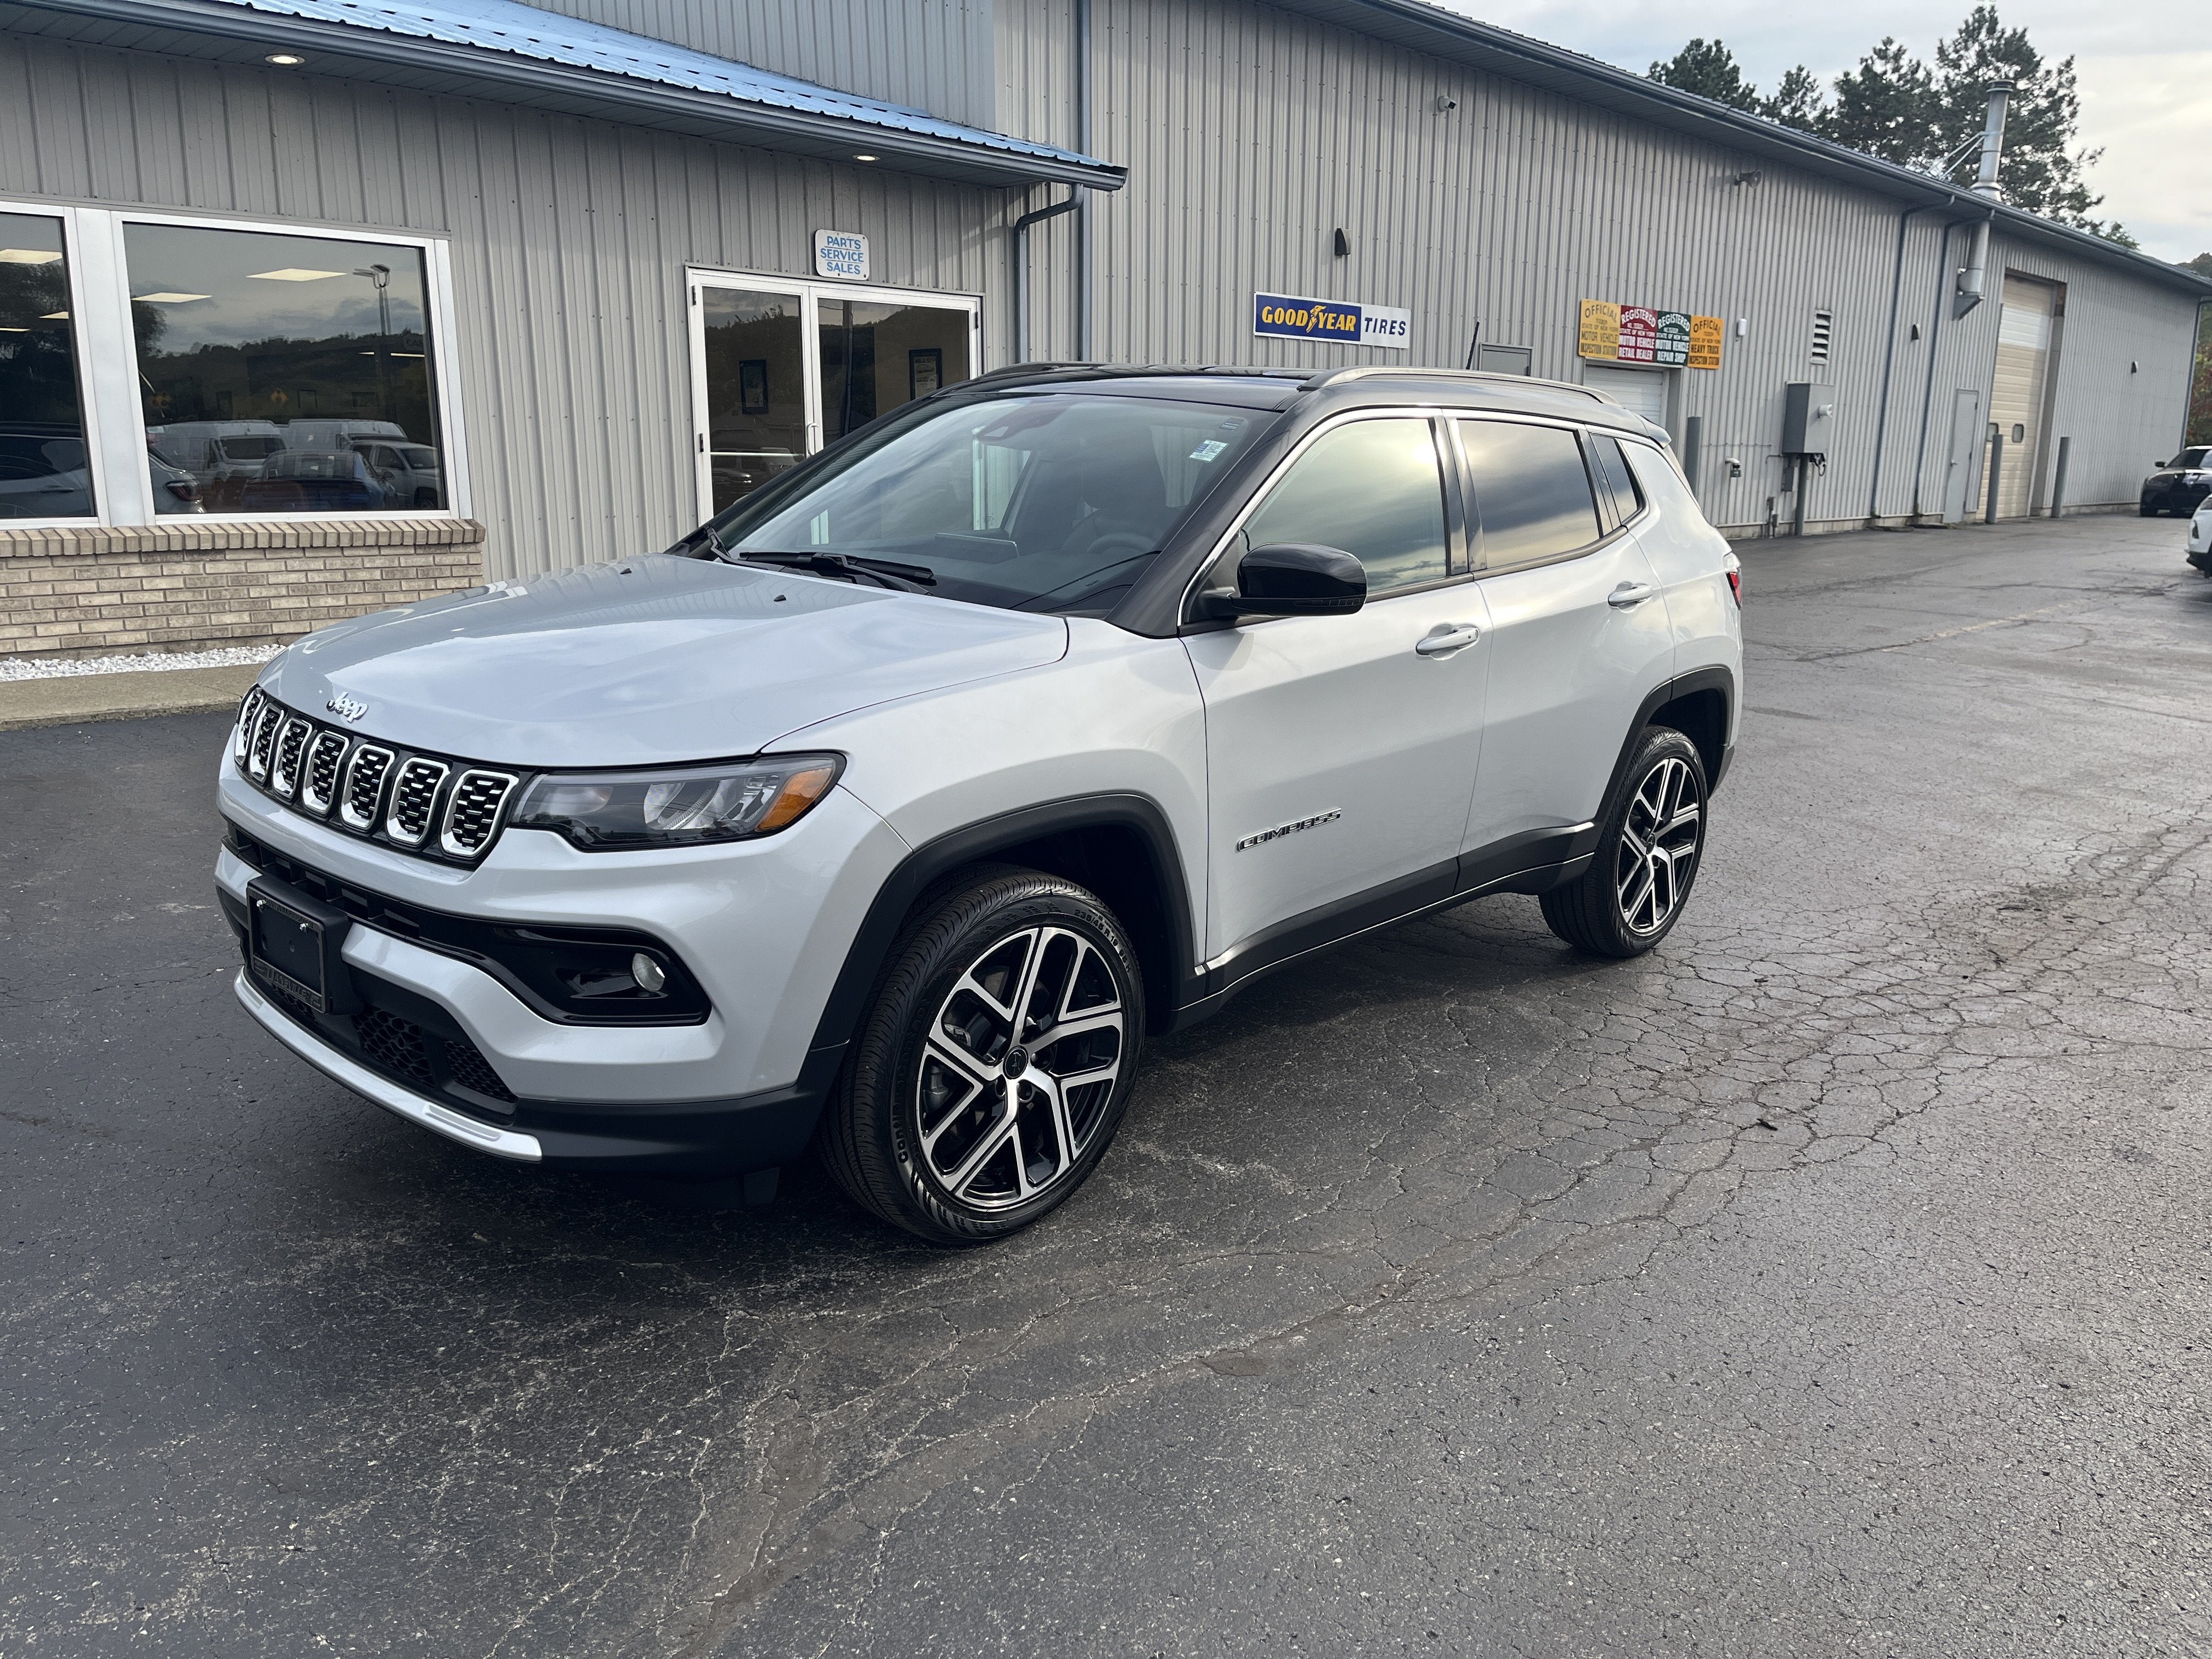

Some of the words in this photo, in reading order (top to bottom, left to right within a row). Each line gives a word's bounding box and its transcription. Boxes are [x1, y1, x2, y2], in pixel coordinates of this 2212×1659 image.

[827, 236, 861, 249] PARTS
[820, 248, 864, 262] SERVICE
[827, 262, 860, 275] SALES
[1262, 305, 1357, 332] GOODYEAR
[1364, 317, 1406, 336] TIRES
[1585, 304, 1617, 323] OFFICIAL
[1621, 308, 1656, 328] REGISTERED
[1658, 313, 1690, 331] REGISTERED
[1581, 330, 1598, 342] MOTOR
[1600, 332, 1618, 344] VEHICLE
[1694, 320, 1720, 336] OFFICIAL
[326, 692, 368, 723] Jeep
[1237, 808, 1342, 851] COMPASS
[1074, 909, 1104, 930] 235/45
[1104, 928, 1110, 937] R
